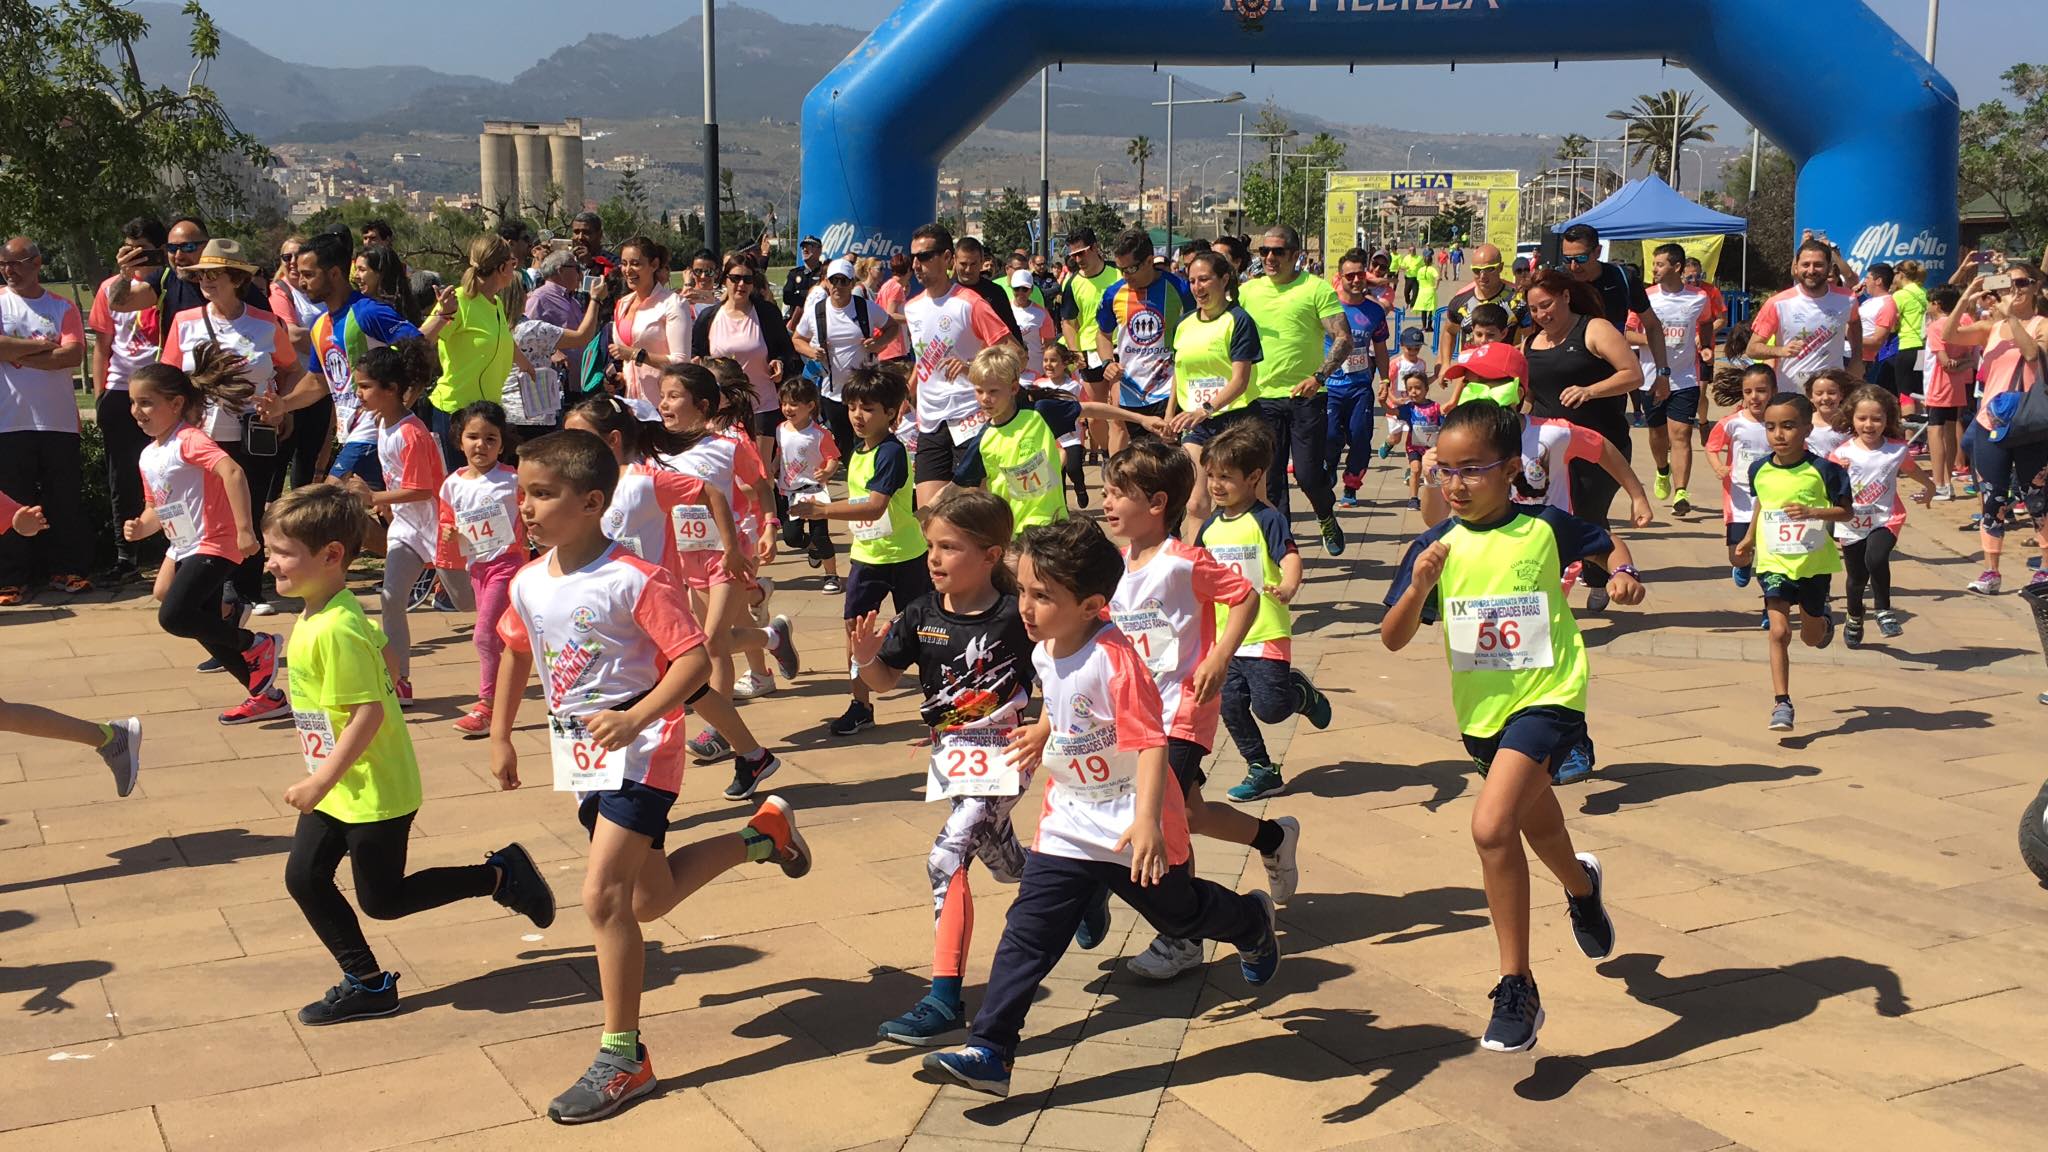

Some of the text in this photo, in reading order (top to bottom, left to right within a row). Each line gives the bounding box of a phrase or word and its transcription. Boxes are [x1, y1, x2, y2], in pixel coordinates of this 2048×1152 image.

[1394, 174, 1449, 188] META
[1195, 388, 1219, 403] 351
[1017, 472, 1041, 491] 71
[1764, 511, 1774, 520] IX
[1851, 515, 1873, 529] 34
[468, 520, 494, 541] 14
[680, 521, 706, 538] 49
[1779, 524, 1806, 541] 57
[1451, 601, 1467, 616] IX
[1518, 596, 1529, 605] POR
[1529, 595, 1540, 604] LAS
[1477, 604, 1541, 620] ENFERMEDADES RARAS
[1478, 620, 1521, 651] 56
[948, 736, 992, 747] ENFERMEDADES
[1095, 728, 1108, 738] POR
[573, 740, 608, 770] 62
[1062, 739, 1104, 756] ENFERMEDADES
[947, 749, 989, 777] 23
[1069, 755, 1110, 784] 19
